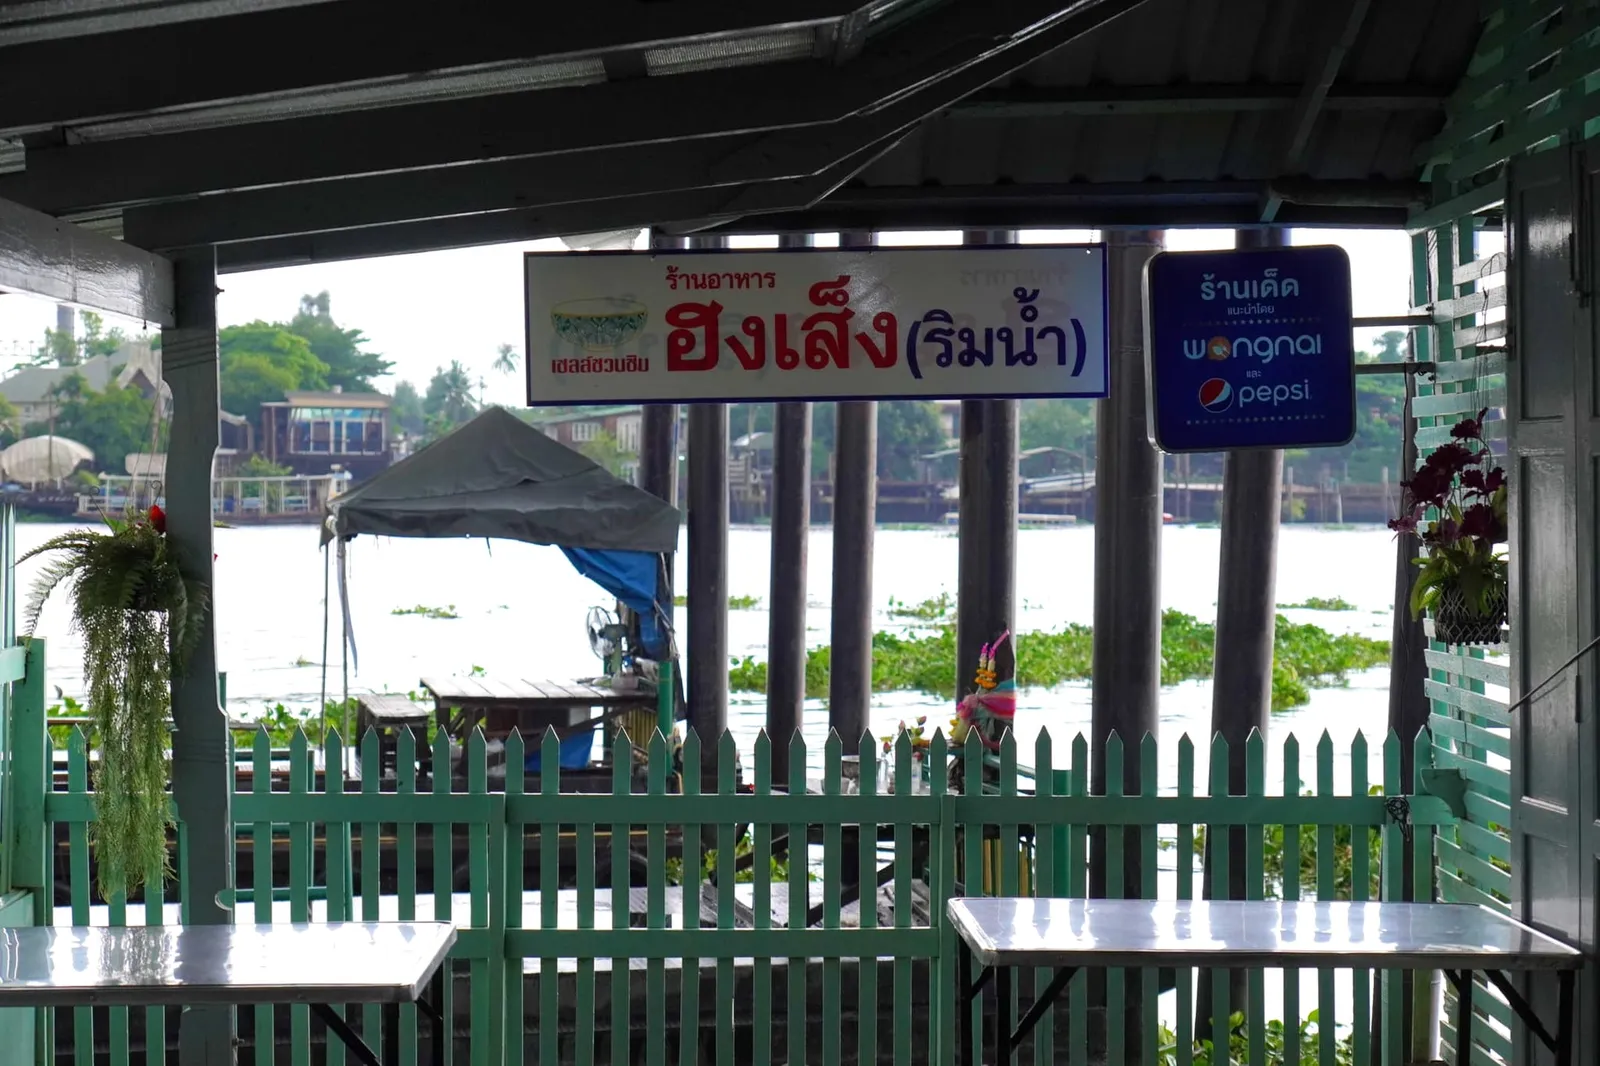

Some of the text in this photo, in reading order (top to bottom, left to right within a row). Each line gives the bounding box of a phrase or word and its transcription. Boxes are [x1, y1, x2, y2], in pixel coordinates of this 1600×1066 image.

[665, 265, 776, 290] ร้านอาหาร
[1200, 268, 1299, 300] ร้านเด็ด
[1227, 303, 1275, 315] แนะนำโดย
[1246, 369, 1262, 379] และ
[1239, 379, 1310, 408] pepsi
